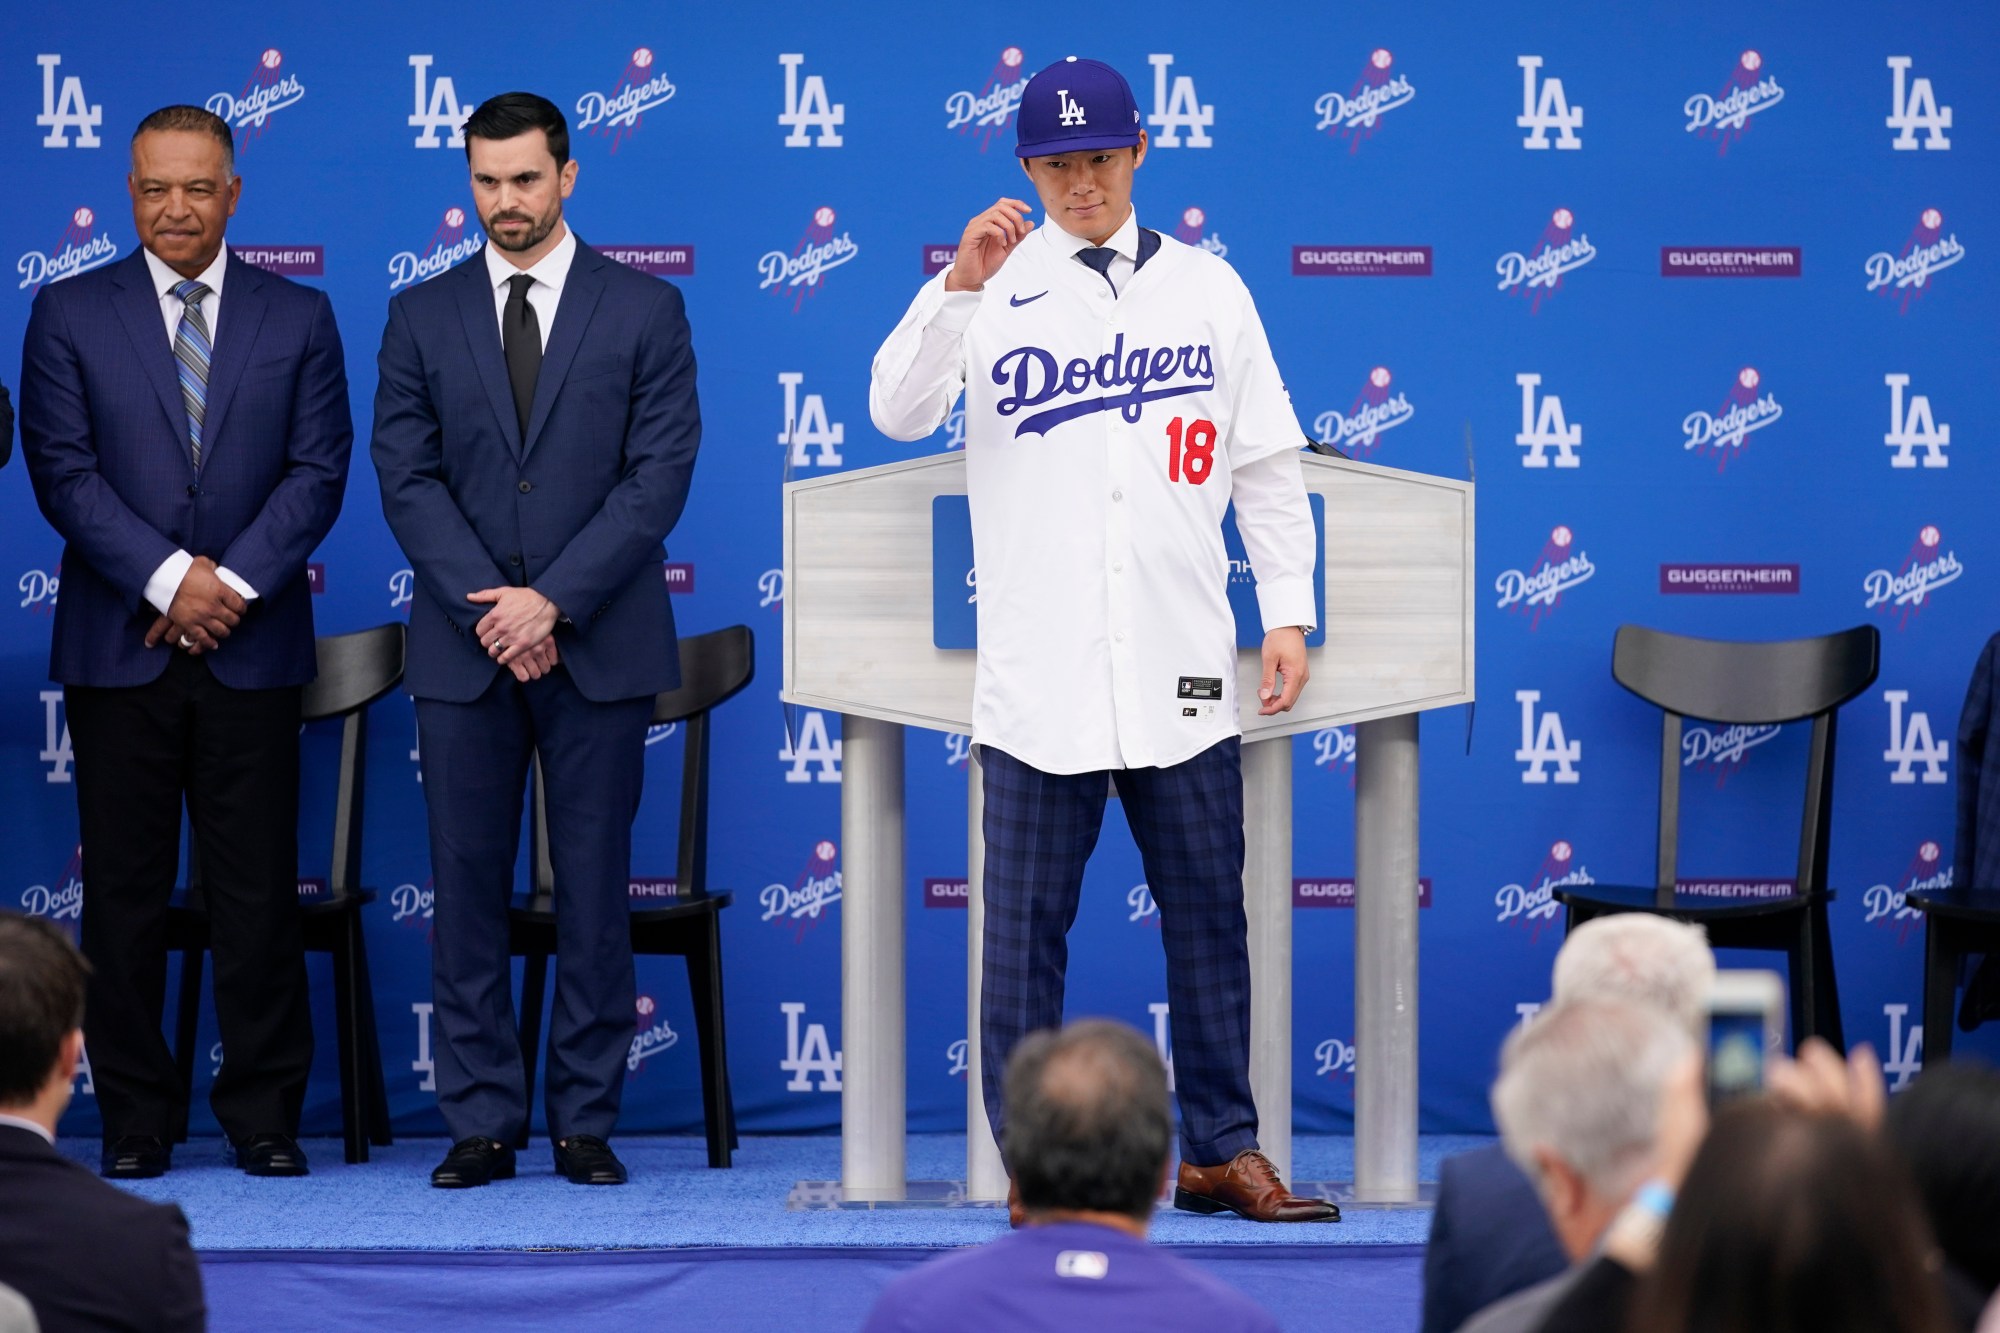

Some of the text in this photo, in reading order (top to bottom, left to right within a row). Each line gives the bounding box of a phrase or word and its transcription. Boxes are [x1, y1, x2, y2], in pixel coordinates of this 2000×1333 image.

[36, 54, 102, 148] LA
[205, 73, 305, 128] Dodgers
[408, 54, 474, 149] LA
[576, 73, 676, 130] Dodgers
[778, 53, 845, 148] LA
[1057, 89, 1087, 126] LA
[1147, 53, 1214, 148] LA
[1315, 74, 1415, 131] Dodgers
[1516, 55, 1583, 150] LA
[1684, 75, 1785, 132] Dodgers
[1886, 56, 1952, 151] LA
[17, 232, 117, 289] Dodgers
[388, 232, 483, 290] Dodgers
[758, 232, 858, 289] Dodgers
[1300, 251, 1425, 265] GUGGENHEIM
[1496, 233, 1596, 291] Dodgers
[1669, 252, 1794, 266] GUGGENHEIM
[1865, 234, 1965, 291] Dodgers
[991, 332, 1214, 439] Dodgers
[777, 372, 844, 467] LA
[1314, 392, 1414, 447] Dodgers
[1515, 373, 1582, 468] LA
[1683, 393, 1783, 449] Dodgers
[1884, 373, 1950, 468] LA
[1165, 416, 1217, 485] 18
[1495, 552, 1596, 609] Dodgers
[1667, 569, 1792, 583] GUGGENHEIM
[1864, 551, 1964, 608] Dodgers
[1515, 690, 1582, 784] LA
[1883, 690, 1949, 784] LA
[780, 1002, 842, 1092] LA
